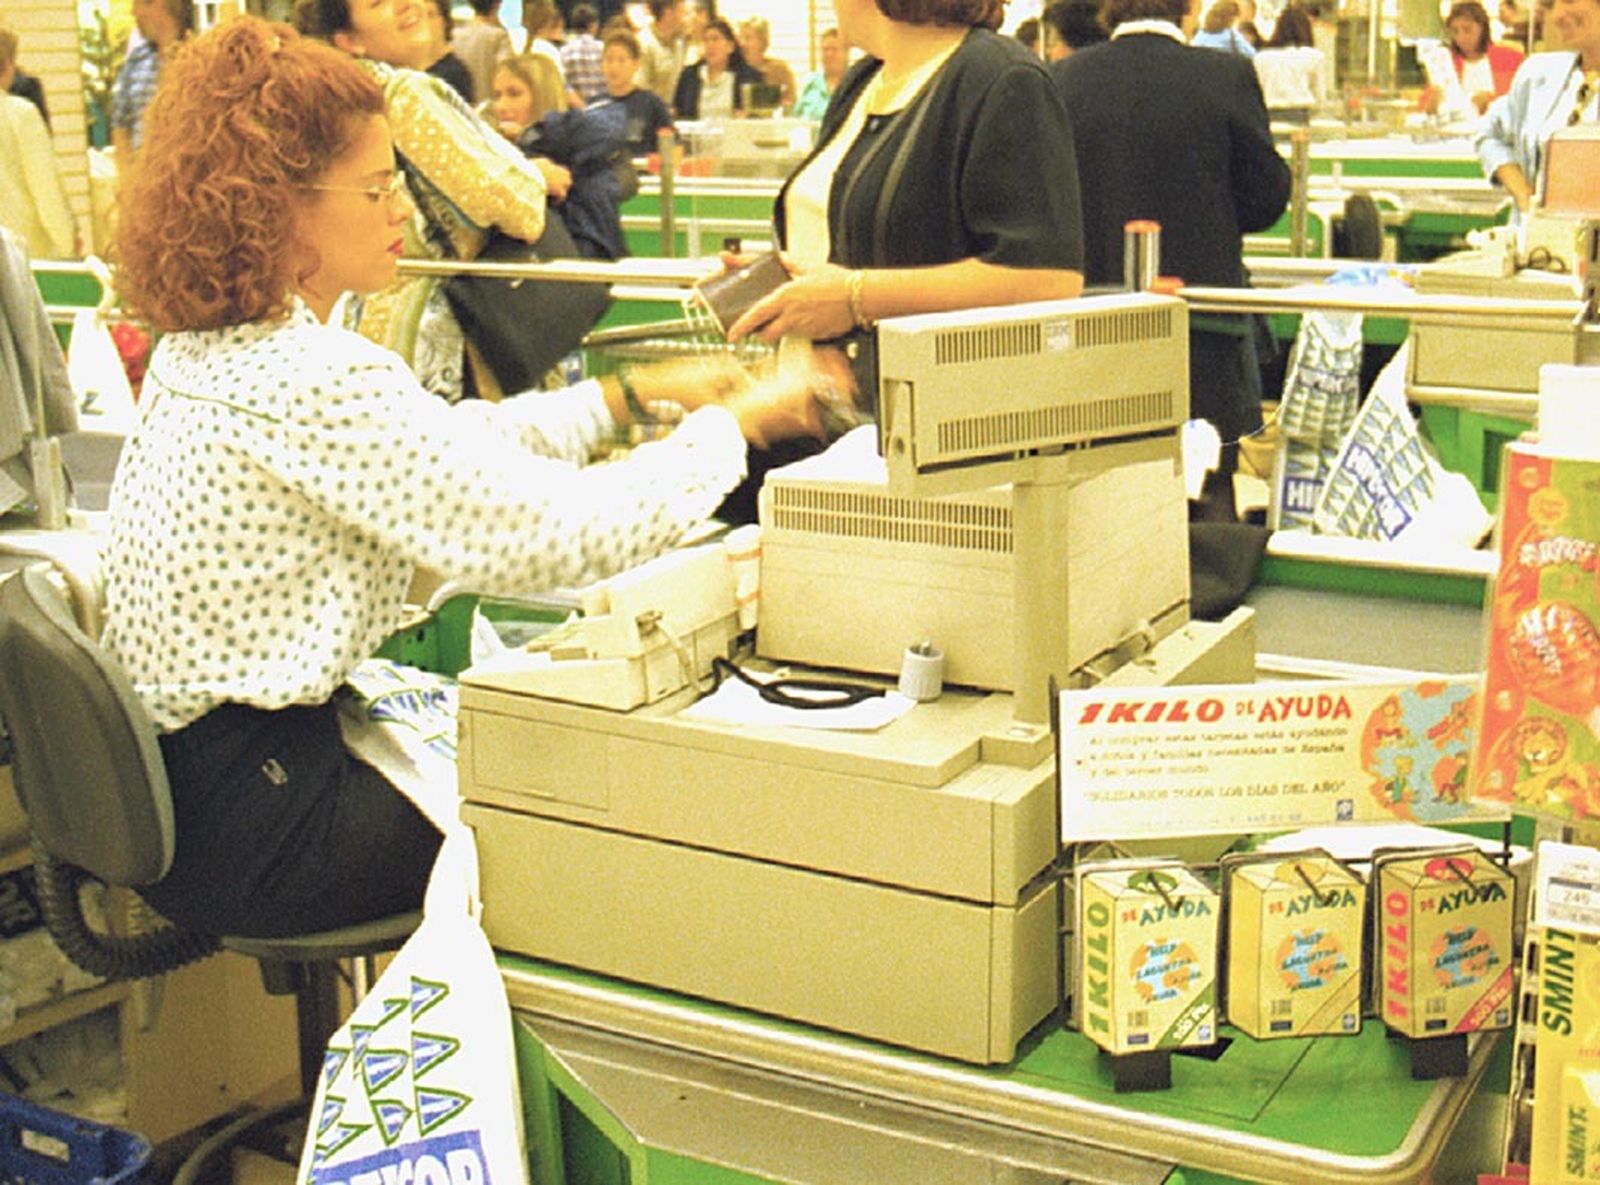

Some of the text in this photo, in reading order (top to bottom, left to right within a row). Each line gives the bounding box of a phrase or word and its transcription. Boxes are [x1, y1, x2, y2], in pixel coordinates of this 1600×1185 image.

[1235, 700, 1255, 716] DE
[1258, 693, 1352, 723] AYUDA
[1219, 785, 1244, 798] LOS
[1282, 783, 1309, 796] DEL
[1139, 900, 1212, 927] AYUDA
[1542, 928, 1577, 1037] SMINT
